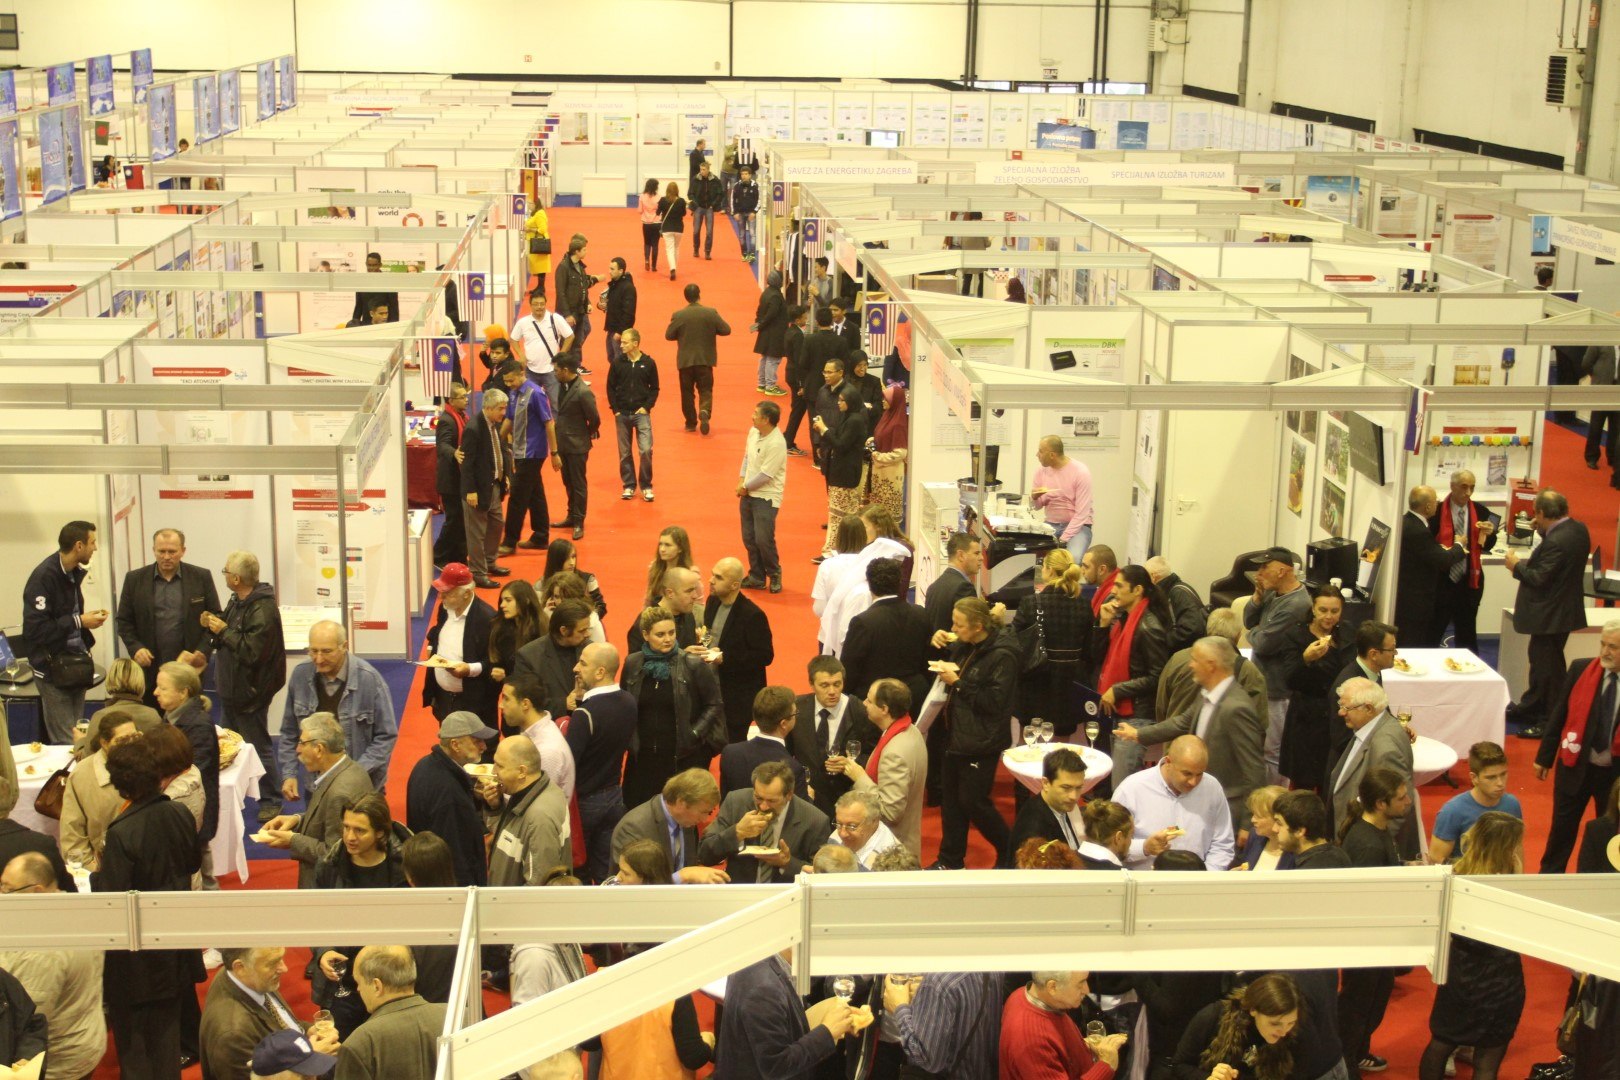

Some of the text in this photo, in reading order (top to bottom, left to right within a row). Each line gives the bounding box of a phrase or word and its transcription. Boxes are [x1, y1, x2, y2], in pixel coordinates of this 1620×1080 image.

[787, 167, 913, 175] SAVEZ ZA ENERGETIKU ZAGREBA
[1002, 164, 1081, 174] SPECIJALNA IZLOŽBA
[1111, 169, 1226, 179] SPECIJALNA IZLOŽBA TURIZAM
[1025, 176, 1089, 185] GOSPODARSTVO
[377, 209, 399, 217] world
[35, 595, 46, 610] 3
